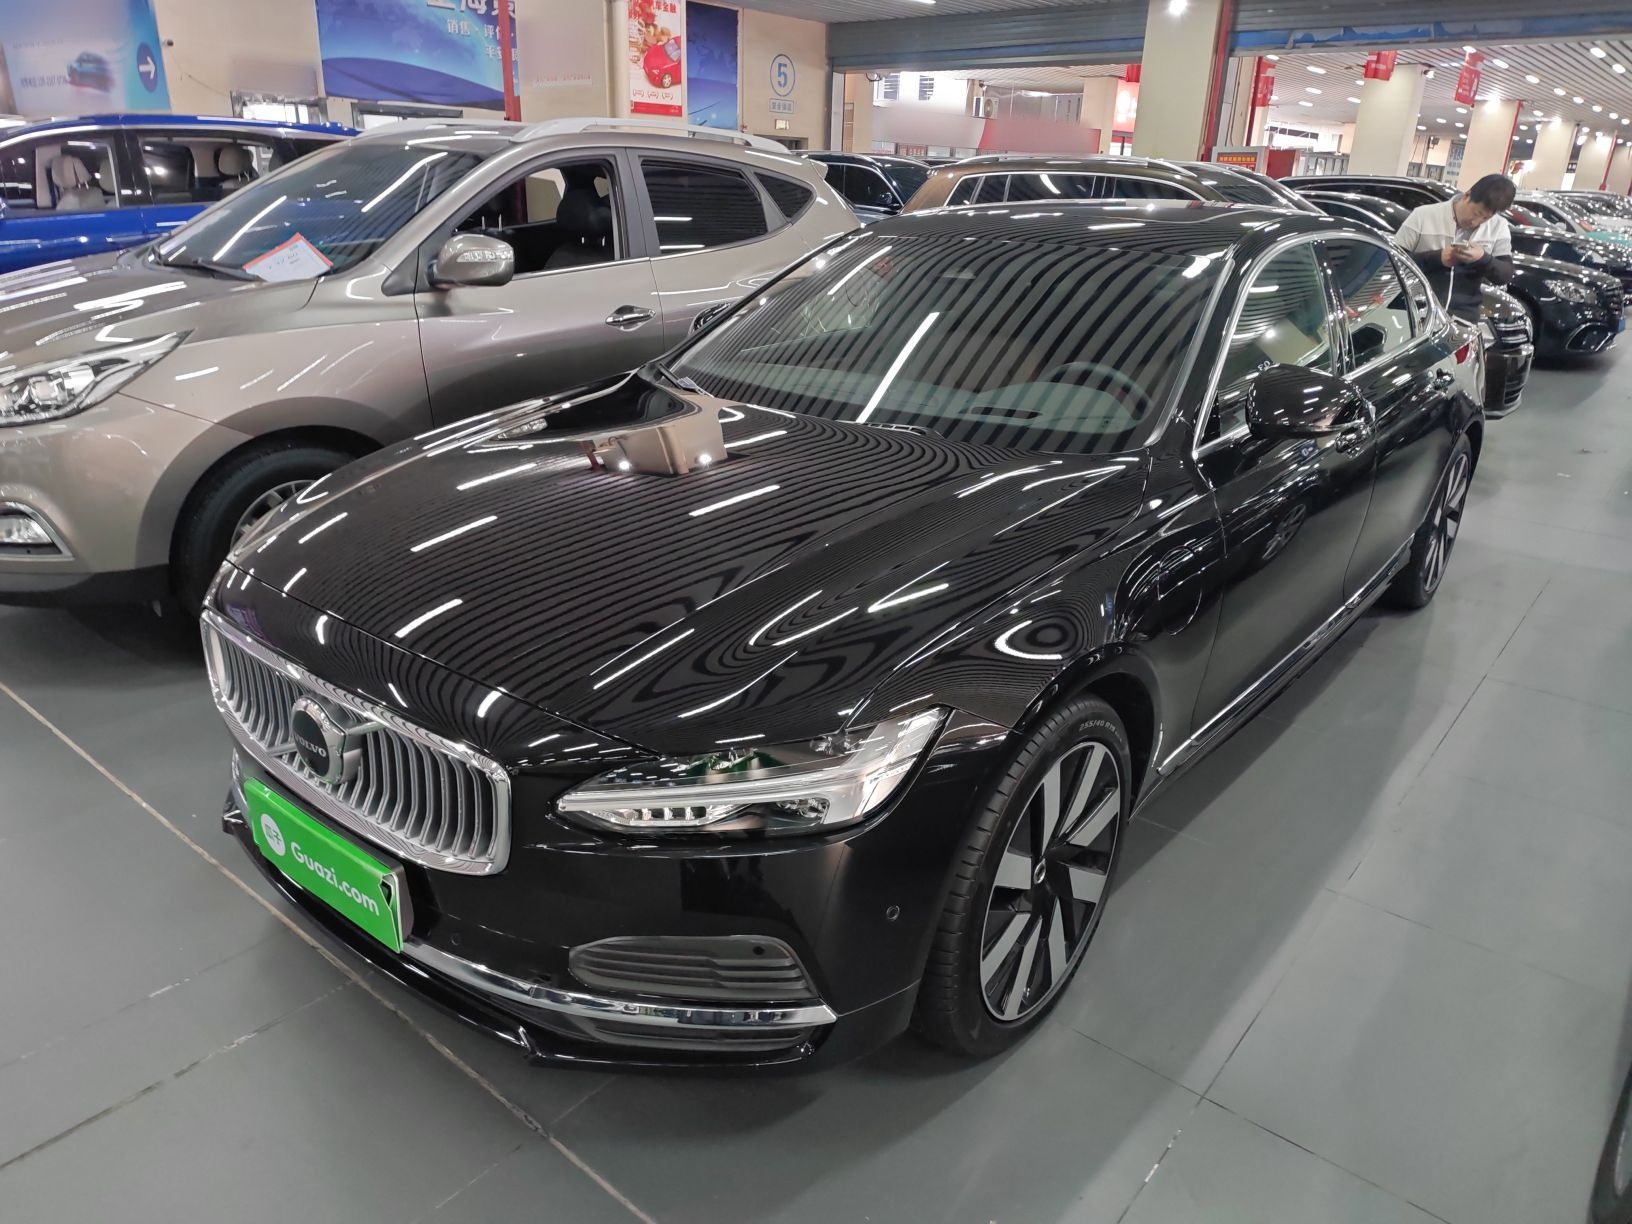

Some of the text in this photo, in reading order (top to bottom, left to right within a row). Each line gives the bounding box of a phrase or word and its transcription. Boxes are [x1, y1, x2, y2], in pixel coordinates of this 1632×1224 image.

[777, 62, 788, 88] 5
[293, 732, 327, 757] VOLVO
[290, 841, 380, 916] Guazi.com
